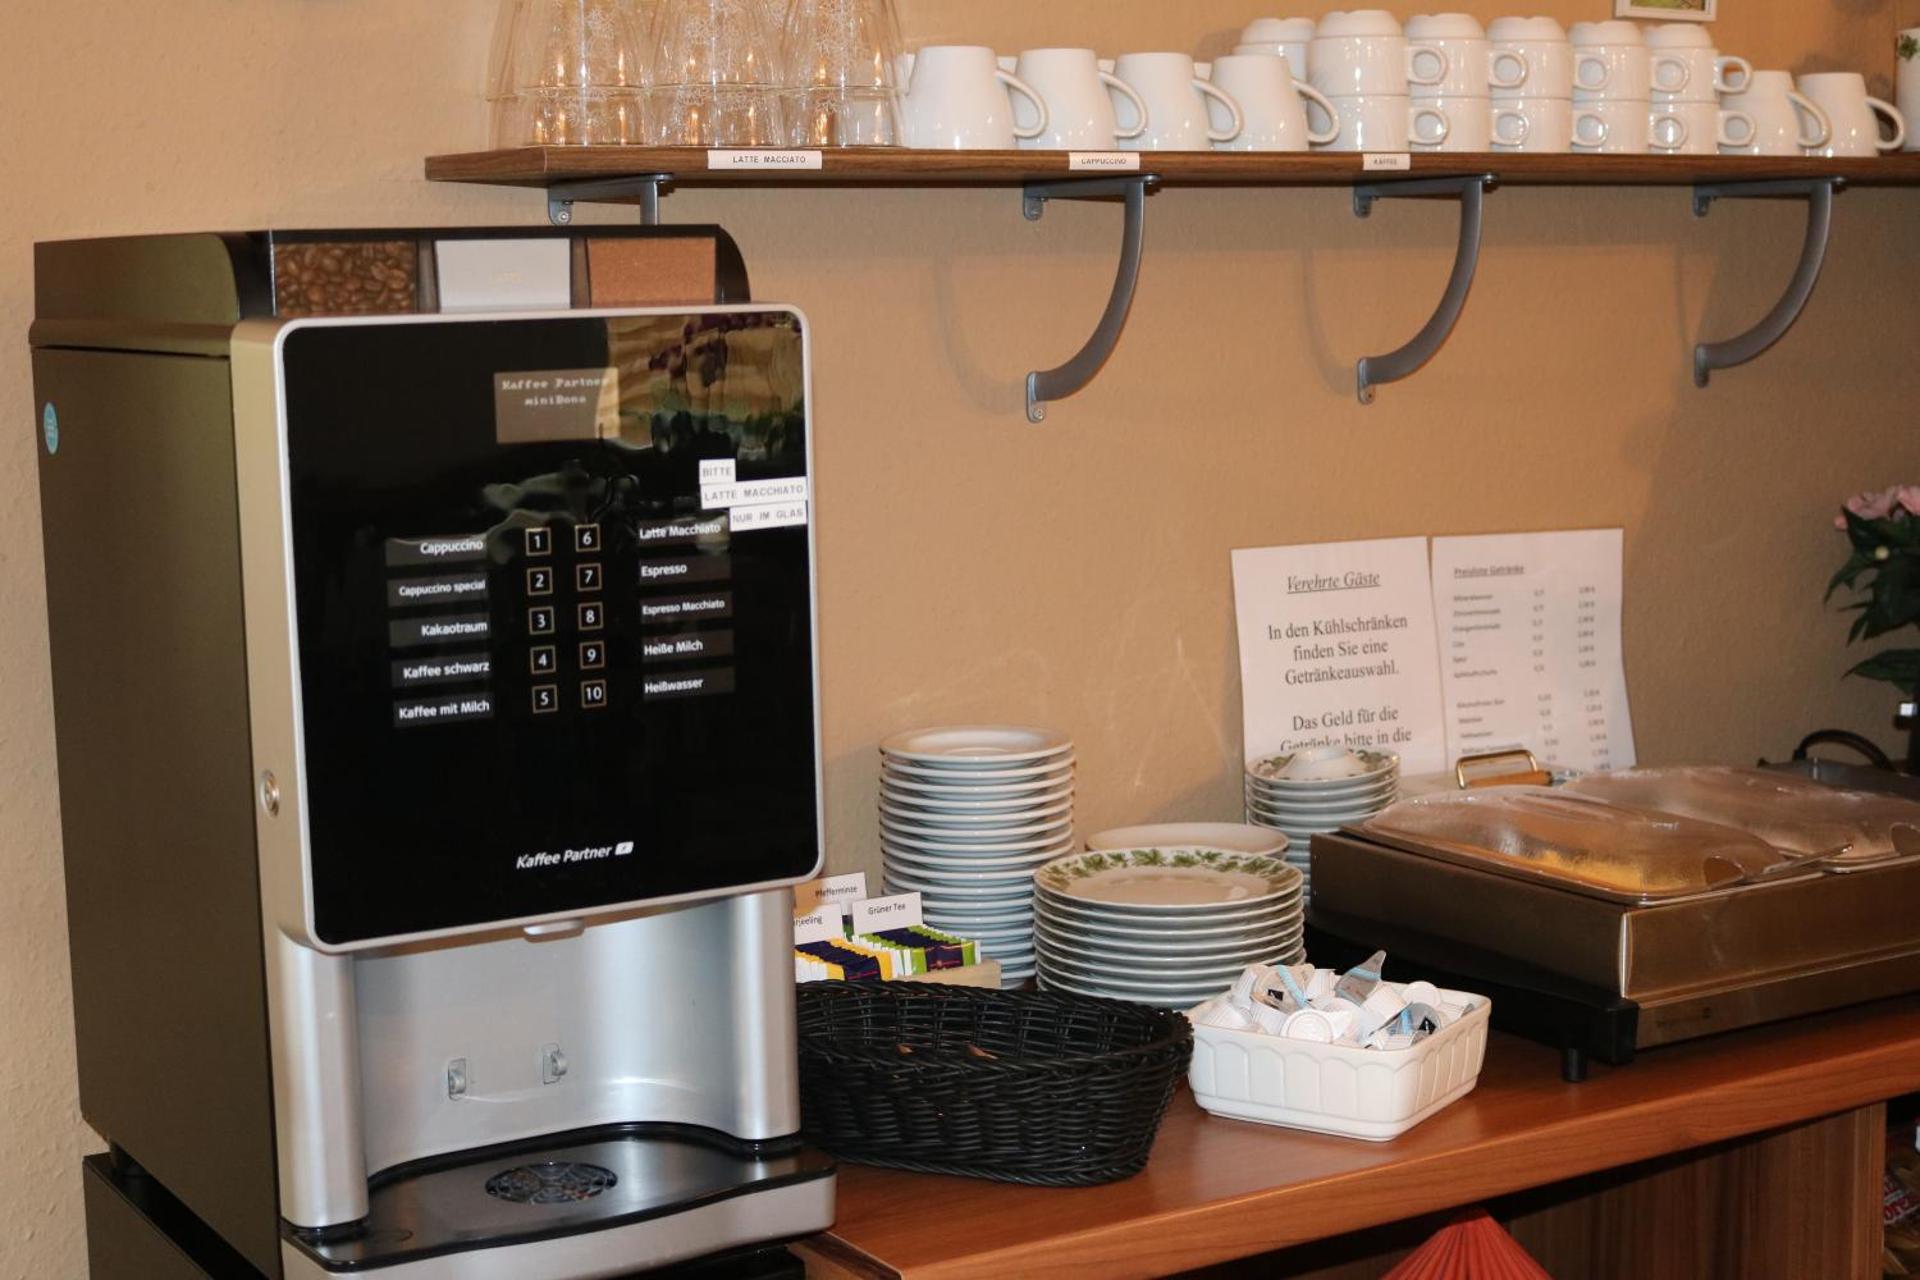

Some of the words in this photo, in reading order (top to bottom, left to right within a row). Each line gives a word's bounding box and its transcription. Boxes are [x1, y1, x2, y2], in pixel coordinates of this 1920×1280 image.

[732, 155, 759, 164] LATTE
[501, 380, 549, 391] Kaffee
[555, 377, 609, 389] Partner
[702, 466, 732, 478] BITTE
[704, 489, 737, 501] LATTE
[743, 485, 804, 497] MACCHIATO
[732, 512, 753, 523] NUR
[759, 511, 770, 521] IM
[776, 508, 803, 519] GLAS
[582, 531, 593, 546] 6
[640, 528, 667, 540] Latte
[668, 523, 721, 537] Macchiato
[420, 540, 484, 556] Cappuccino
[534, 535, 541, 549] 1
[584, 569, 594, 584] 7
[641, 564, 688, 579] Espresso
[535, 573, 545, 588] 2
[1287, 574, 1340, 592] Verehrte
[1344, 570, 1381, 588] Gäste
[399, 584, 452, 598] Cappuccino
[453, 580, 486, 594] special
[642, 604, 681, 616] Espresso
[682, 599, 725, 612] Macchiato
[537, 613, 546, 628] 3
[585, 608, 595, 624] 8
[421, 622, 488, 637] Kakaotraum
[1268, 624, 1282, 640] In
[1286, 623, 1309, 638] den
[1312, 614, 1408, 636] Kühlschränken
[587, 648, 597, 663] 9
[644, 643, 674, 656] Heiße
[676, 640, 704, 653] Milch
[1293, 644, 1335, 661] finden
[1338, 641, 1359, 657] Sie
[1362, 639, 1389, 654] eine
[538, 653, 548, 667] 4
[403, 665, 442, 679] Kaffee
[443, 662, 490, 676] schwarz
[1284, 659, 1400, 685] Getränkeauswahl.
[586, 686, 602, 701] 10
[645, 679, 704, 694] Heißwasser
[540, 691, 549, 706] 5
[399, 704, 437, 720] Kaffee
[440, 702, 458, 716] mit
[461, 700, 490, 714] Milch
[1293, 715, 1318, 731] Das
[1321, 709, 1353, 728] Geld
[1357, 708, 1376, 724] für
[1379, 705, 1399, 721] die
[1344, 731, 1373, 746] bitte
[1377, 729, 1389, 744] in
[1392, 727, 1412, 742] die
[516, 852, 561, 869] Kaffee
[563, 846, 613, 862] Partner
[815, 885, 858, 898] Pfefferminze
[868, 904, 892, 915] Grüner
[794, 915, 823, 928] rjeeling
